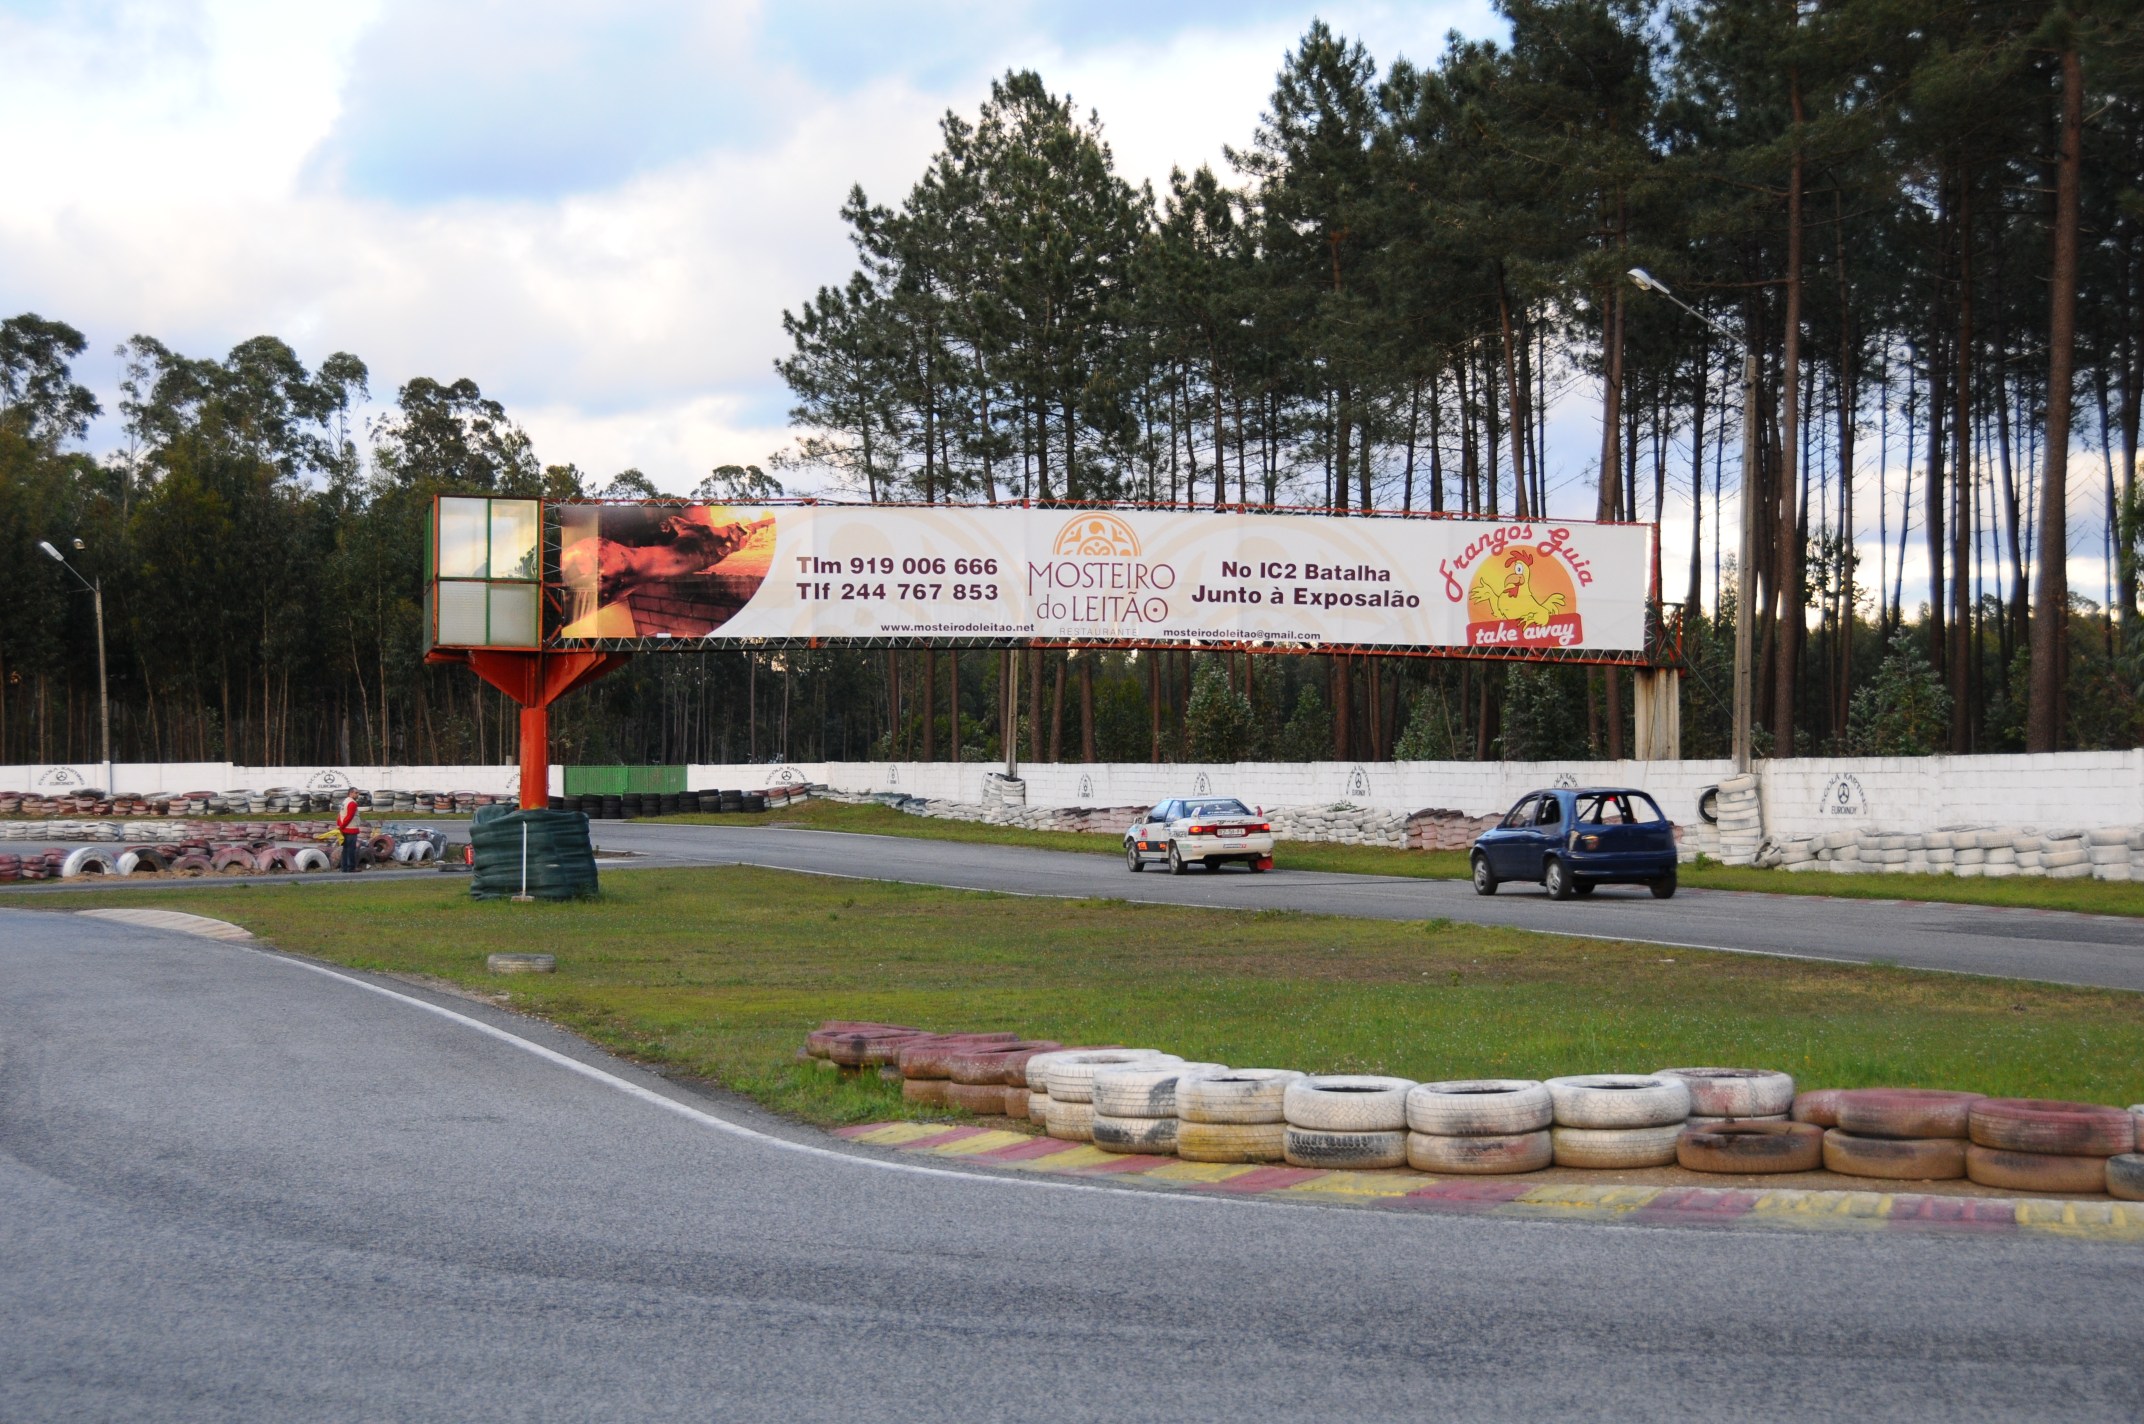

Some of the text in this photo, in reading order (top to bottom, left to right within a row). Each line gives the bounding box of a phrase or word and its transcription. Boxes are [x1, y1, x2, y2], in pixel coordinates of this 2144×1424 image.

[796, 556, 998, 575] Tlm 919 006 666
[1221, 560, 1391, 582] No IC2 Batalha
[1439, 524, 1594, 603] Frangos Guia
[1027, 561, 1176, 597] MOSTEIRO
[796, 582, 999, 601] Tlf 244 767 853
[1191, 585, 1420, 610] Junto à Exposalão
[1036, 591, 1169, 623] do LEITÃO
[880, 622, 1035, 633] www.mosteirodoleitao.net
[1059, 627, 1138, 637] RESTAURANTE
[1163, 627, 1321, 640] mosteirodoleitao@gmail.com
[1475, 622, 1575, 645] take away
